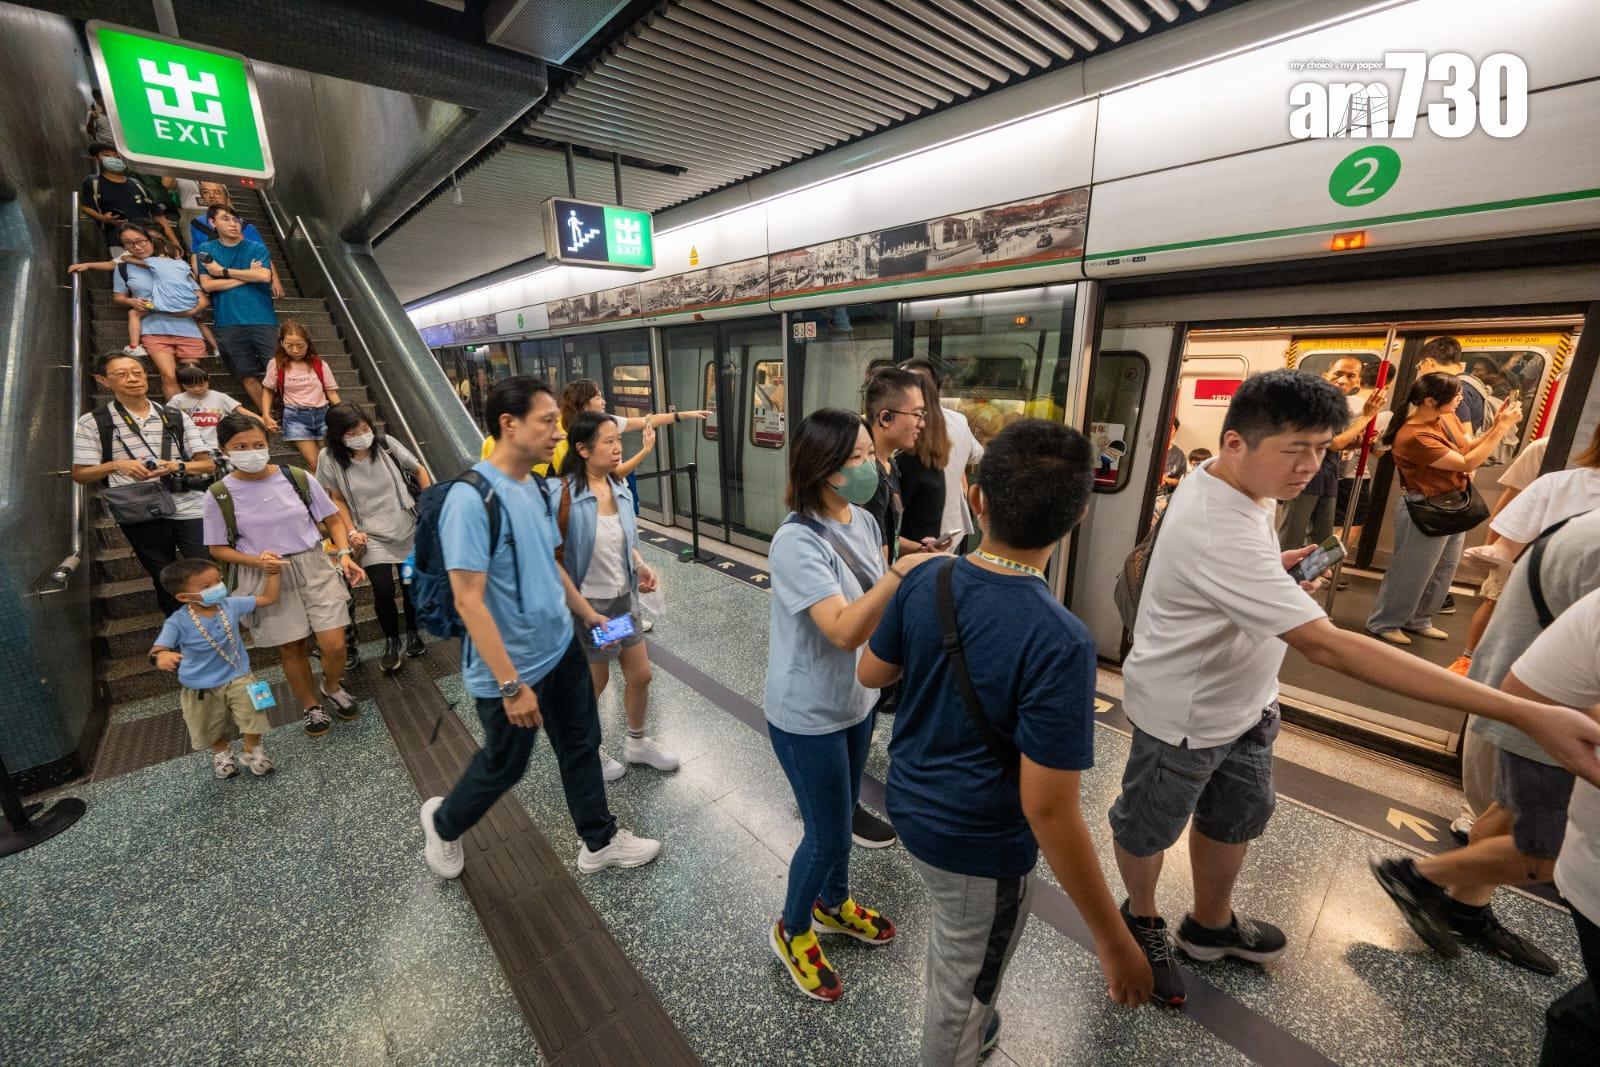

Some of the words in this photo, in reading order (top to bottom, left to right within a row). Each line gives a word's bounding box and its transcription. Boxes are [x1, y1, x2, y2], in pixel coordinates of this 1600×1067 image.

[152, 118, 228, 149] EXIT
[1346, 157, 1380, 197] 2
[616, 245, 643, 257] EXIT
[1465, 336, 1487, 344] Please
[1488, 335, 1509, 343] mind
[1510, 335, 1522, 343] the
[1524, 336, 1540, 344] gap
